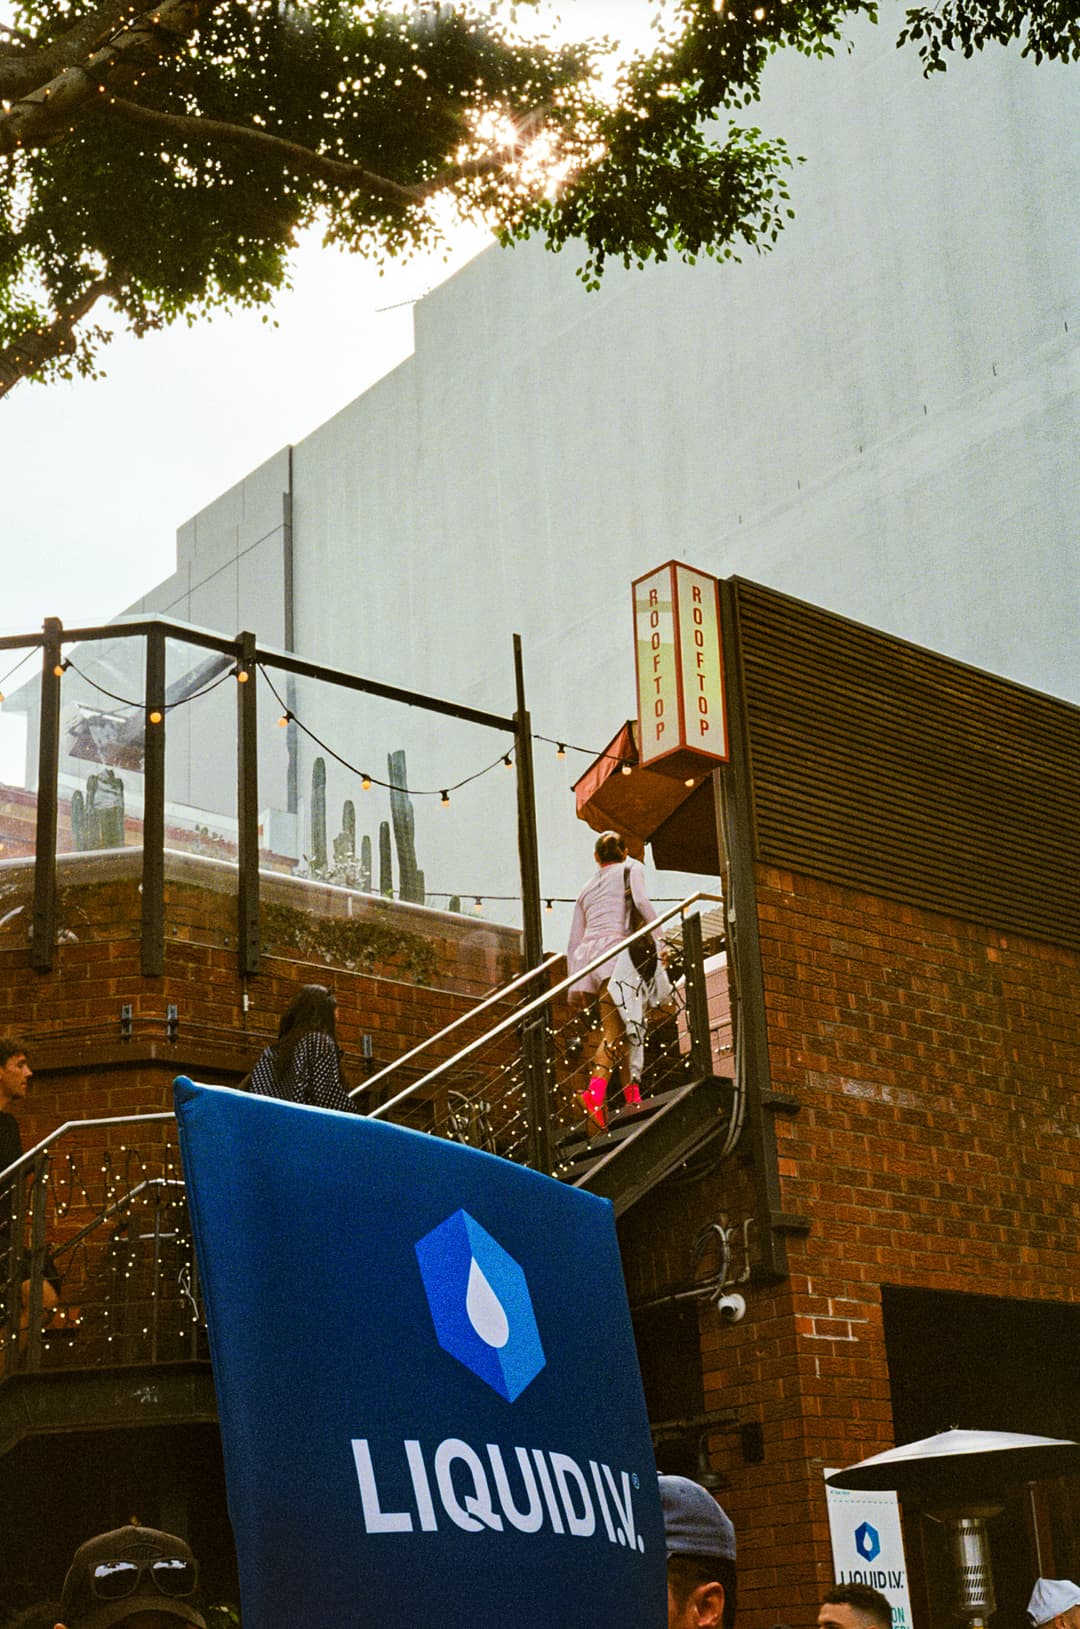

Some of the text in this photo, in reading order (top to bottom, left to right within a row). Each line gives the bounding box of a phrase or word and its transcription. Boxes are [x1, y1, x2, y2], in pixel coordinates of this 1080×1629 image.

[649, 588, 665, 741] ROOFTOP
[692, 585, 709, 737] ROOFTOP
[351, 1438, 596, 1537] LIQUID
